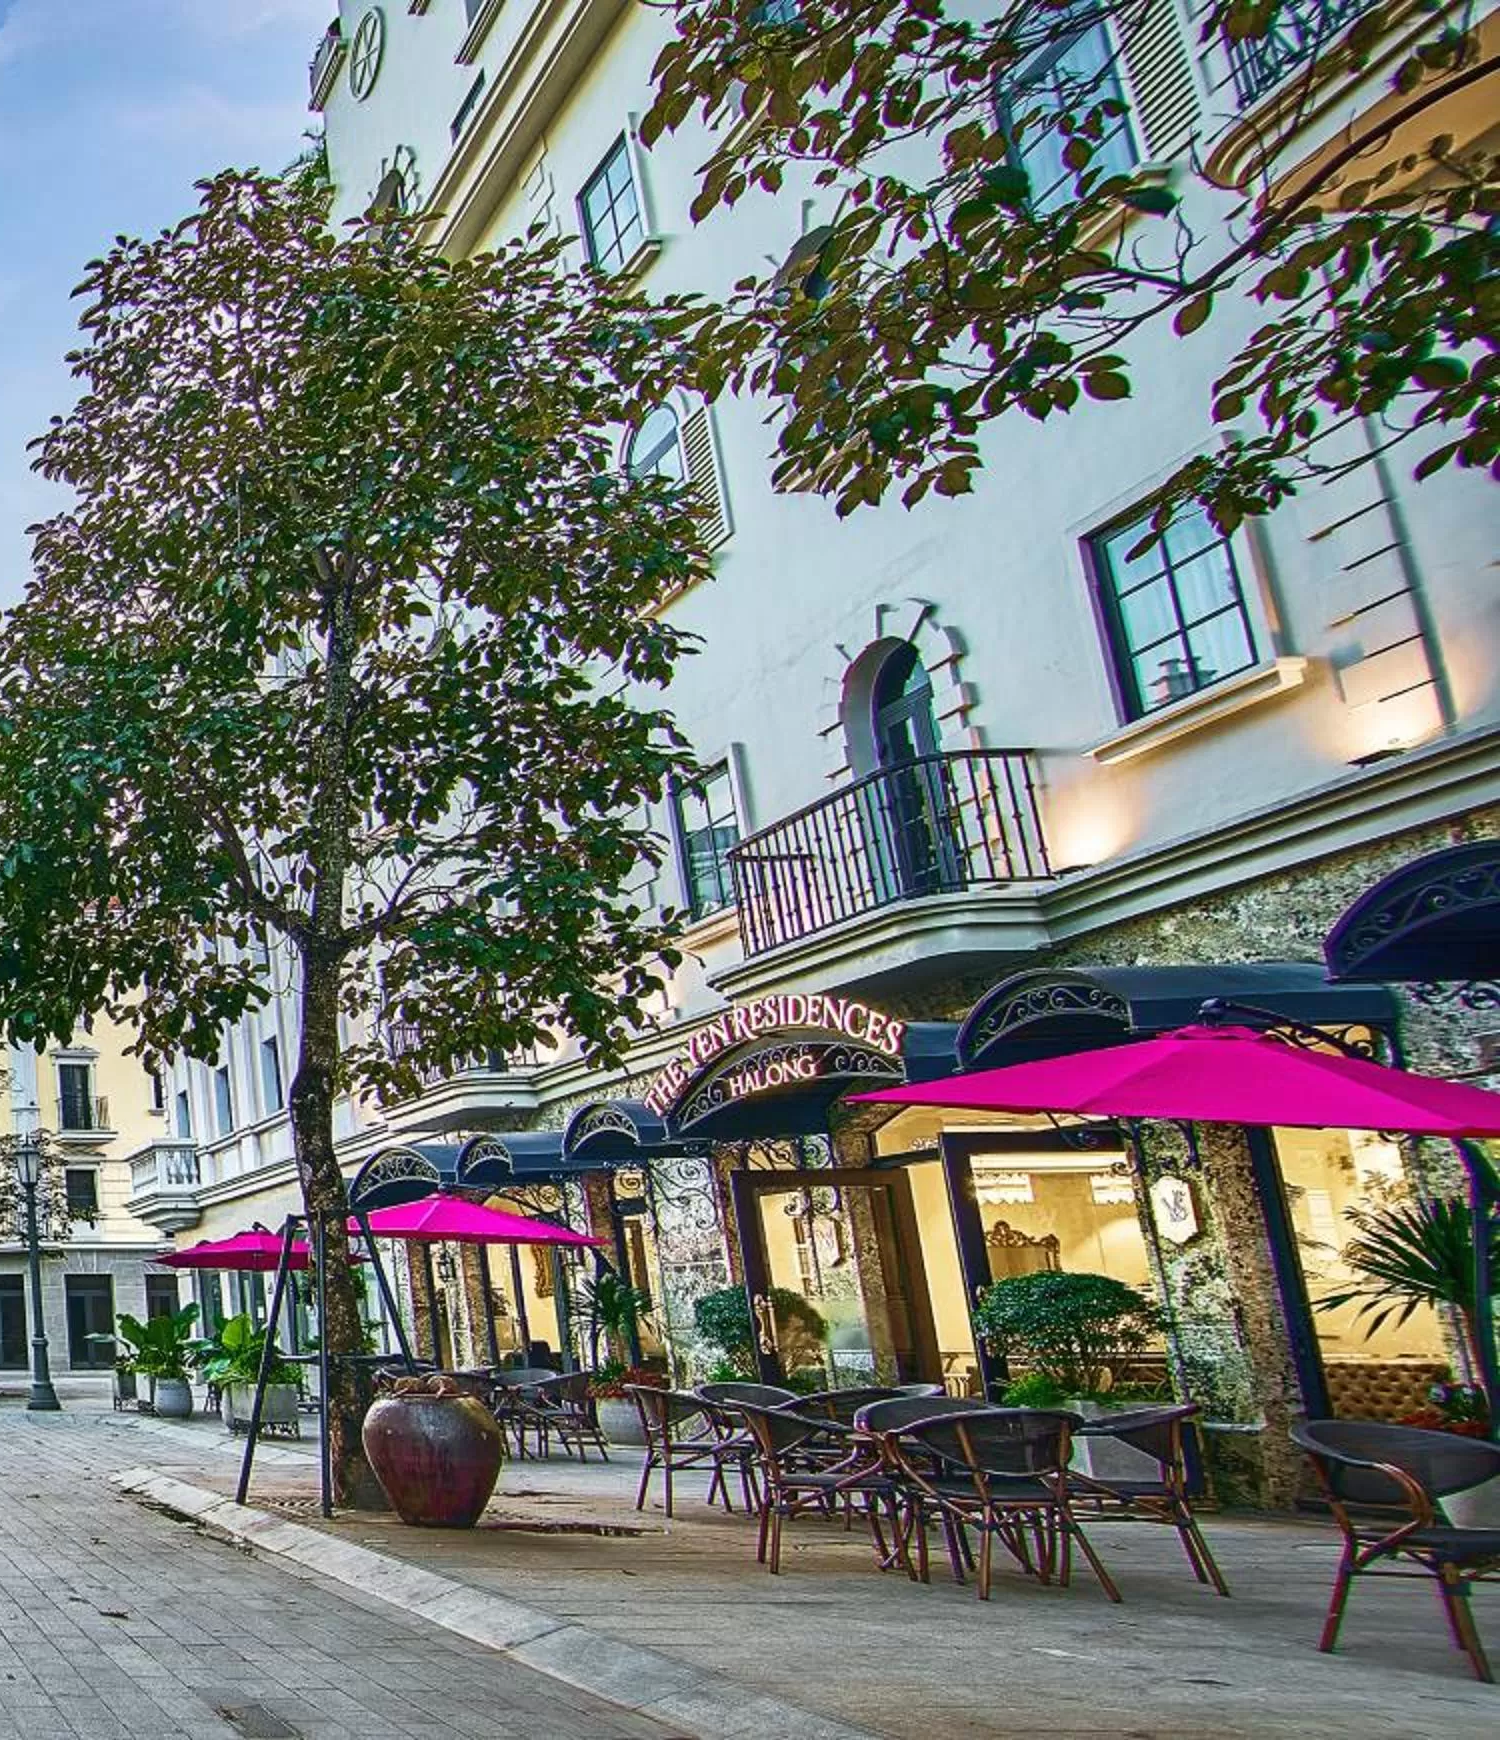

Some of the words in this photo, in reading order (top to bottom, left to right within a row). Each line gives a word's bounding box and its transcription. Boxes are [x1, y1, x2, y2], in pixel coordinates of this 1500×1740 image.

[644, 1057, 688, 1117] THE
[680, 1013, 736, 1068] YEN
[733, 993, 906, 1055] RESIDENCES
[729, 1055, 816, 1097] HALONG
